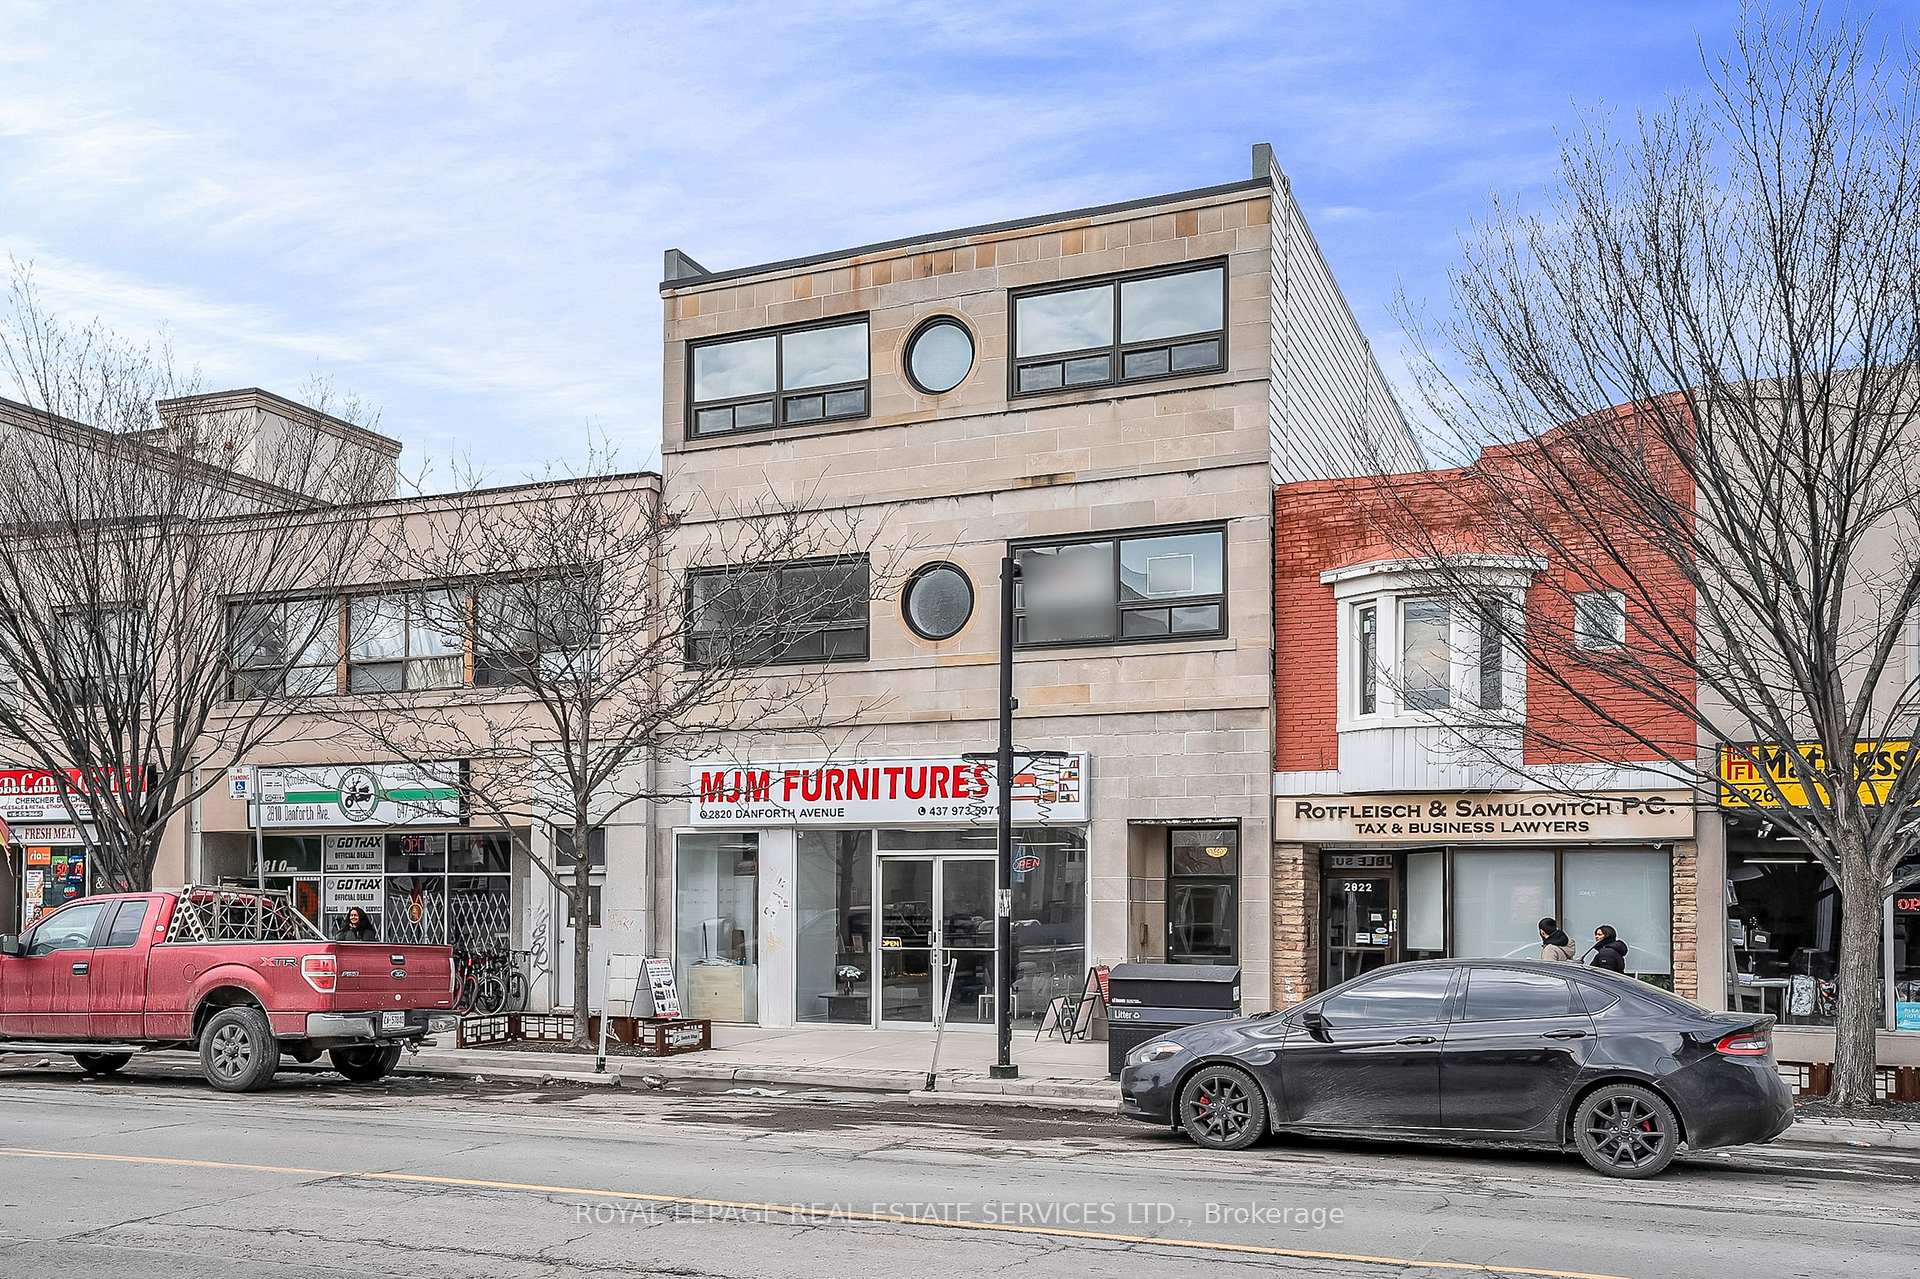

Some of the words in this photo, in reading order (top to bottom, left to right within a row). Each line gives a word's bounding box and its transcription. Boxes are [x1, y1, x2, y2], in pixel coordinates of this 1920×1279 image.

[700, 770, 770, 803] MJM
[783, 764, 990, 802] FURNITURES
[15, 796, 55, 805] CHERCHER
[267, 805, 282, 821] 2810
[284, 805, 314, 821] Danforth
[316, 804, 331, 820] Ave.
[709, 809, 732, 819] 2820
[735, 808, 796, 819] DANFORTH
[800, 807, 845, 818] AVENUE
[929, 806, 948, 816] 437
[951, 806, 970, 816] 973
[1295, 801, 1421, 819] ROTFLEISCH
[1428, 799, 1447, 818] &
[1455, 799, 1610, 818] SAMULOVITCH
[1622, 796, 1675, 815] P.C.
[25, 827, 52, 839] FRESH
[53, 827, 77, 839] MEAT
[1355, 823, 1387, 834] TAX
[1391, 823, 1403, 834] &
[1408, 822, 1495, 834] BUSINESS
[1501, 821, 1590, 833] LAWYERS
[403, 838, 432, 853] OPEN
[1013, 858, 1040, 869] OPEN
[1343, 882, 1373, 892] 2822
[259, 956, 298, 967] XTR
[1114, 1009, 1132, 1019] Litter
